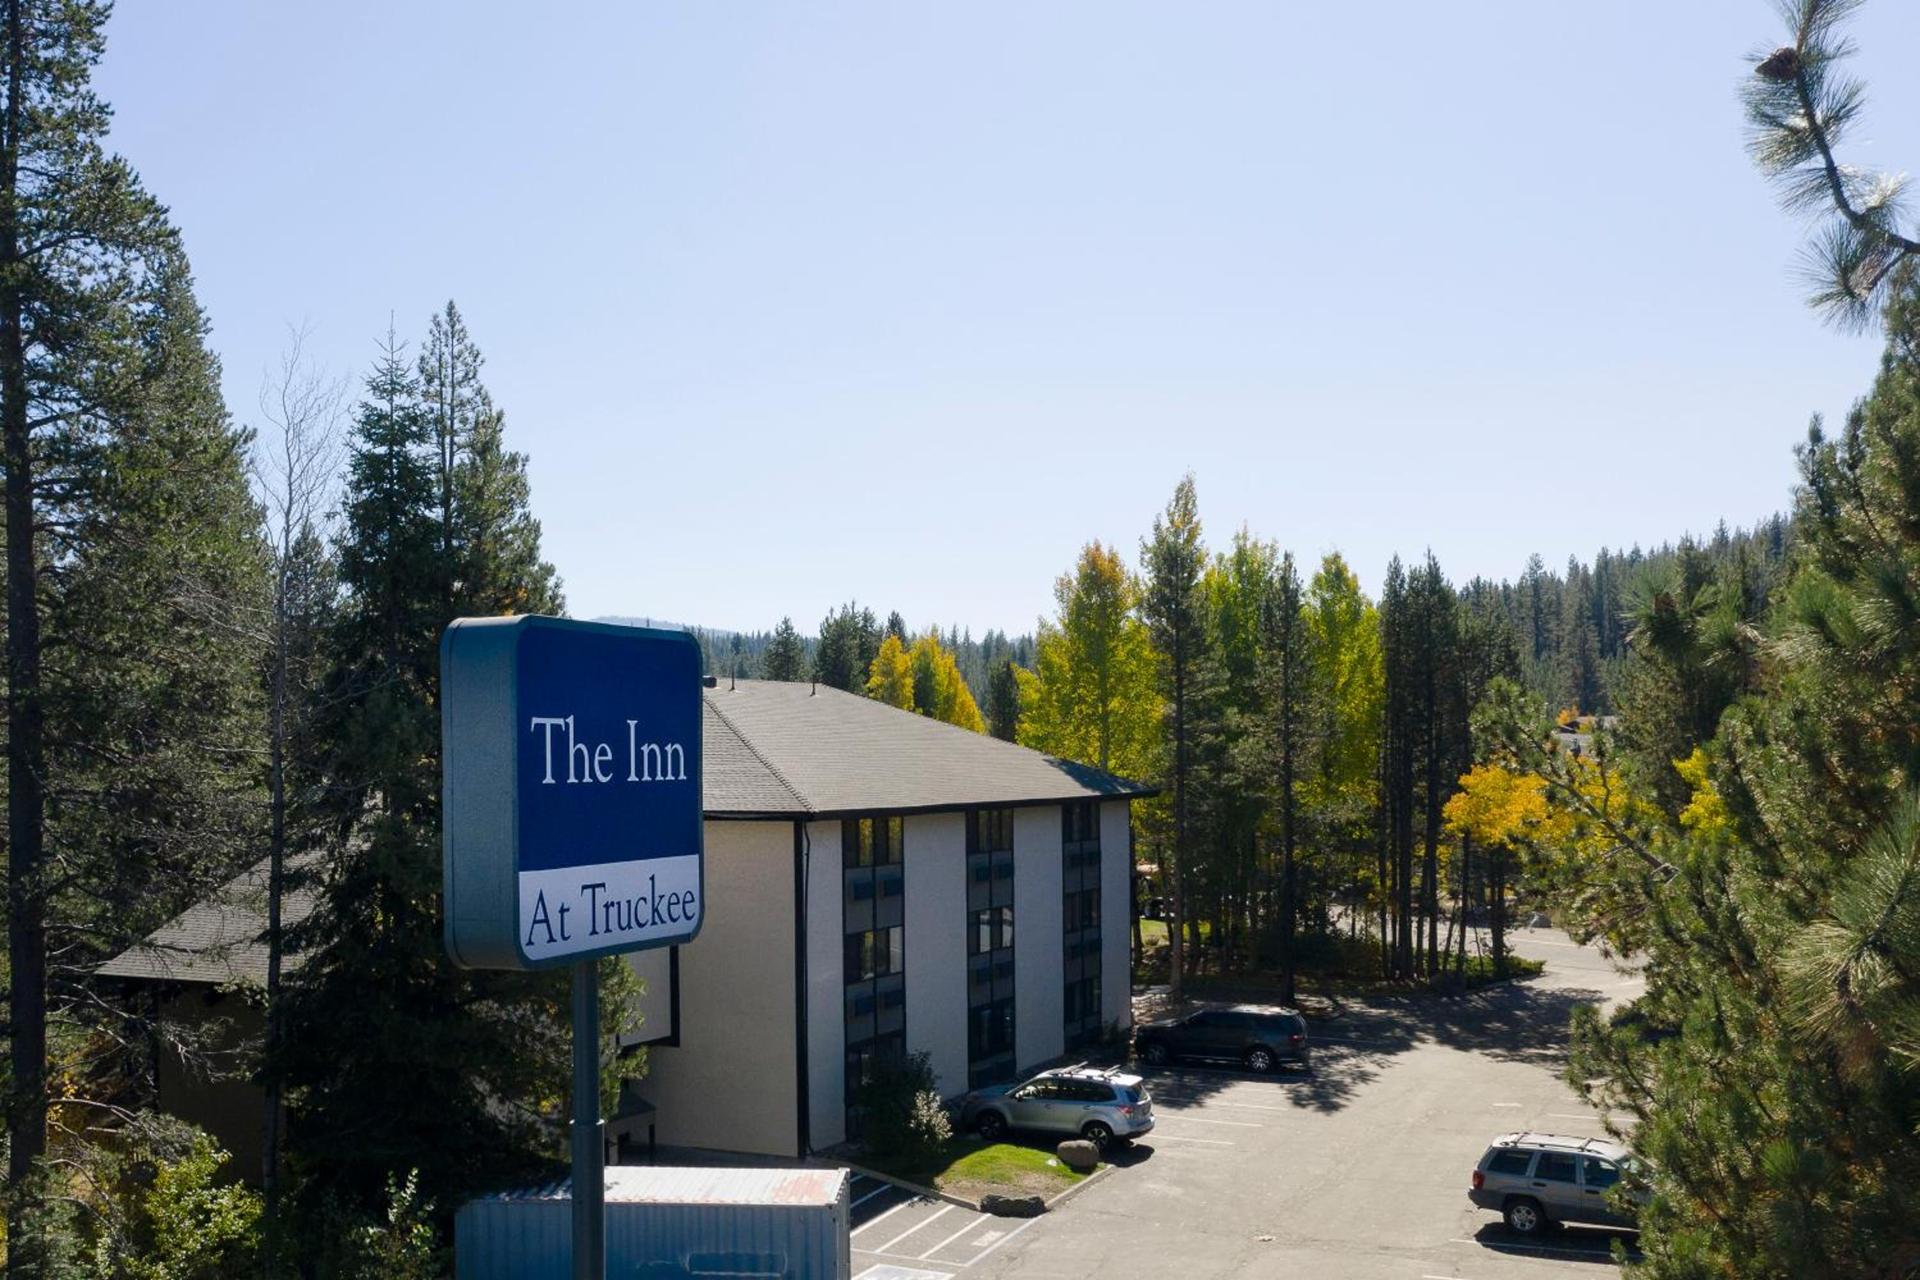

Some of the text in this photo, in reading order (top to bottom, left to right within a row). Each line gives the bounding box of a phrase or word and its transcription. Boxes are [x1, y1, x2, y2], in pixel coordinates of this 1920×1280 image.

[531, 715, 687, 784] The Inn
[526, 874, 696, 946] At Truckee
